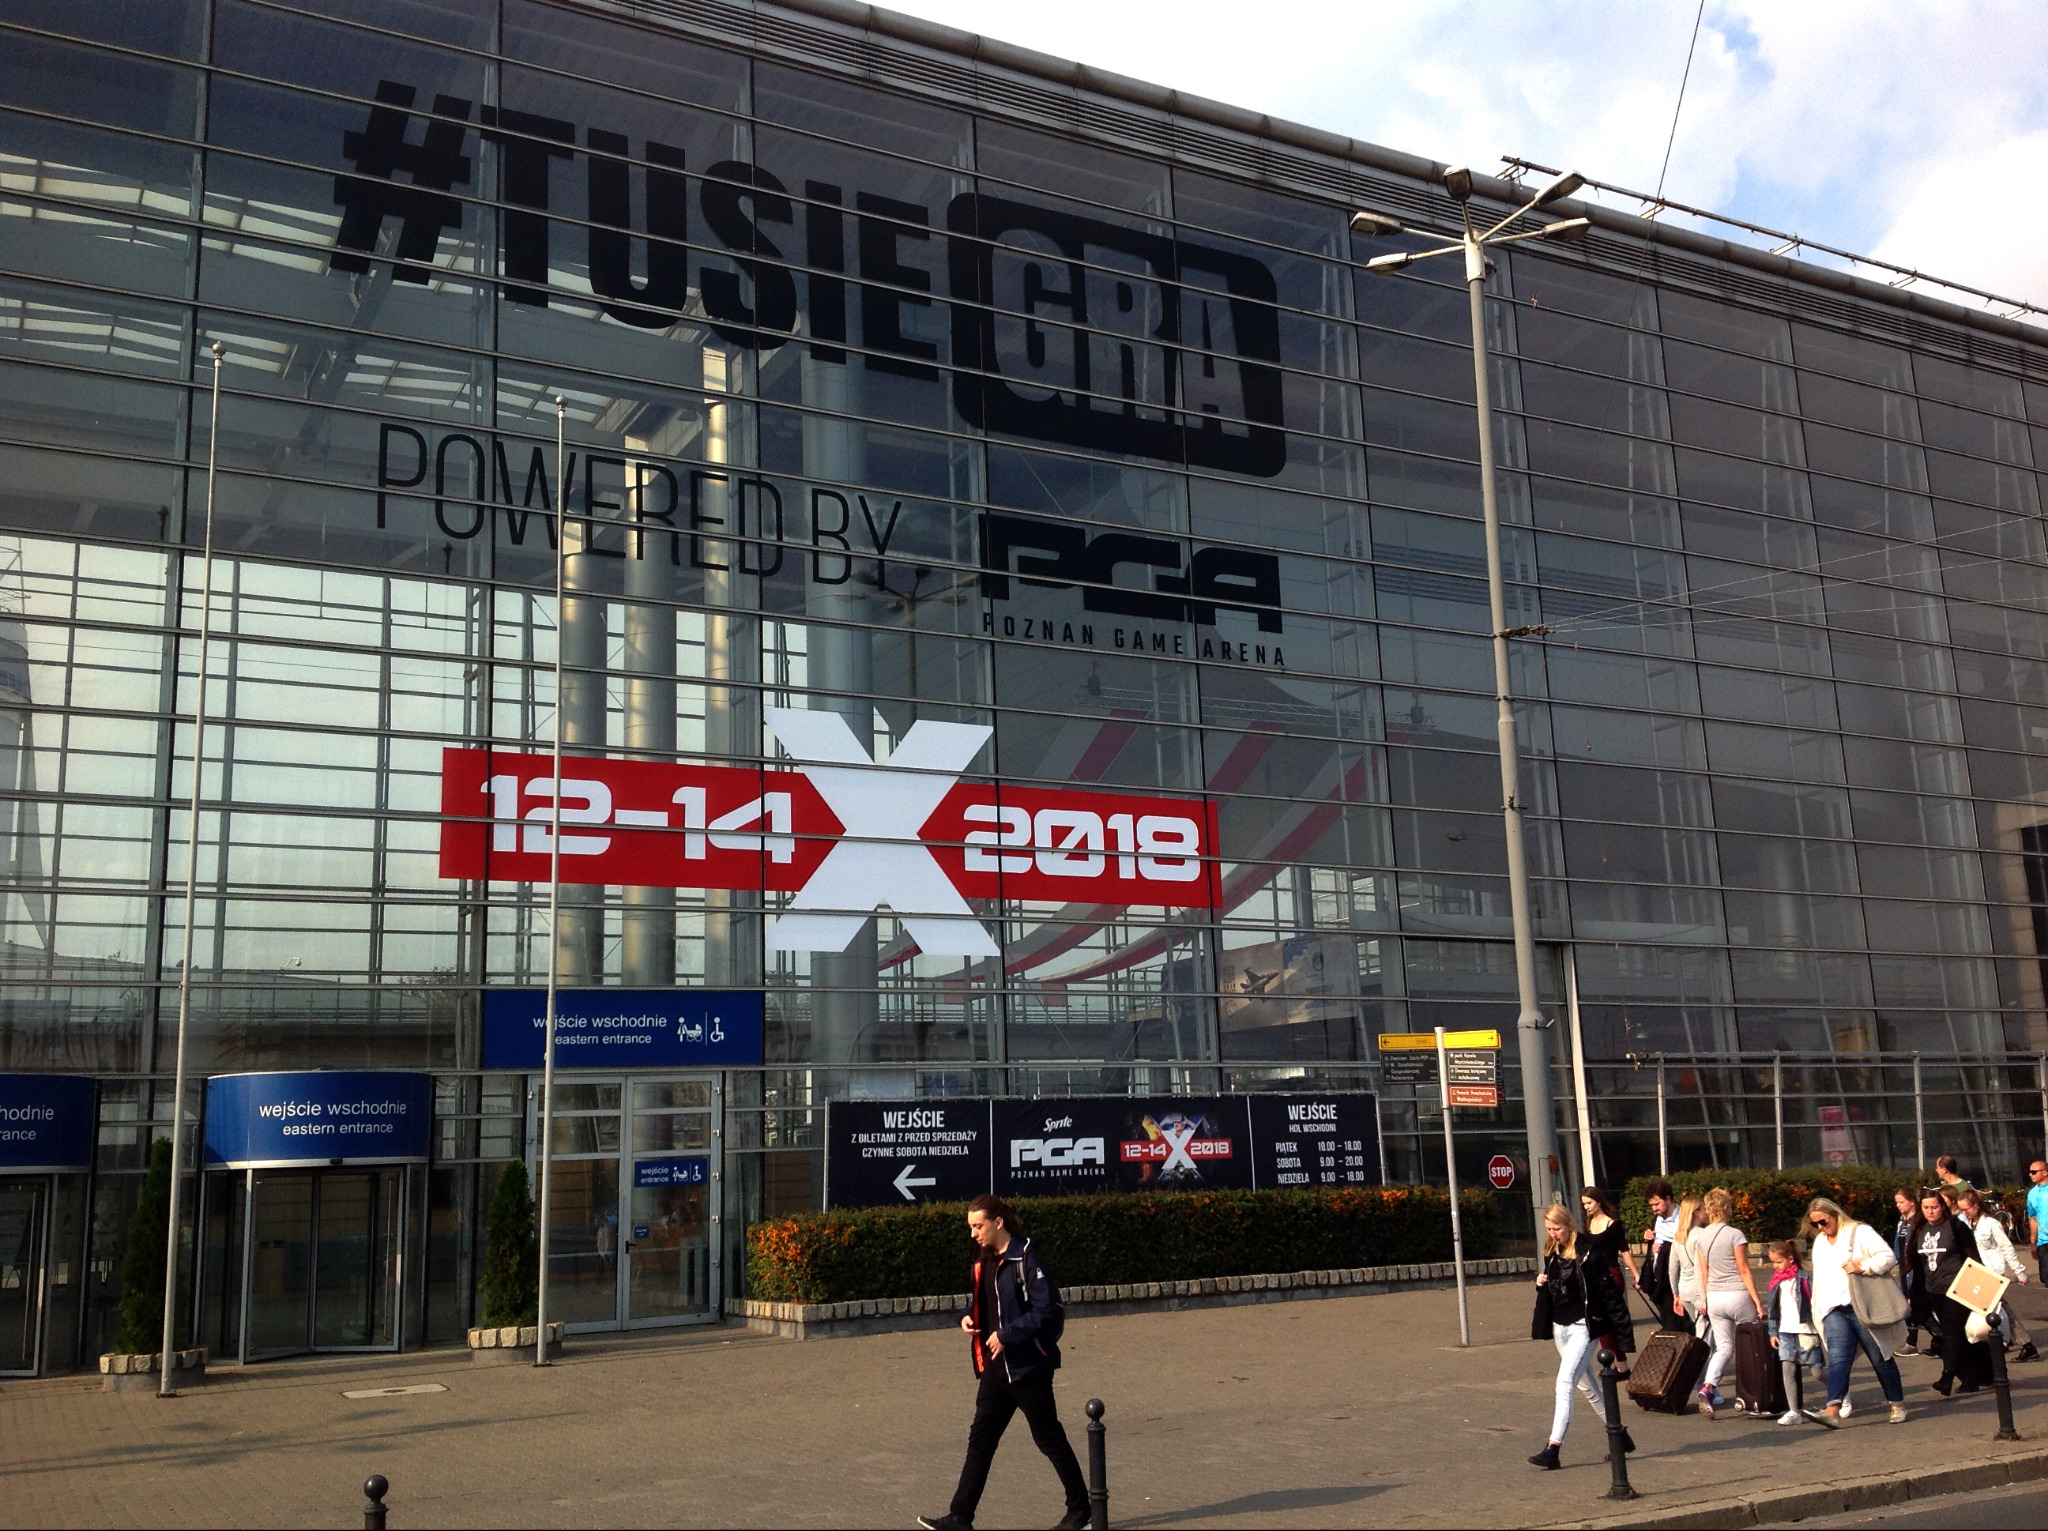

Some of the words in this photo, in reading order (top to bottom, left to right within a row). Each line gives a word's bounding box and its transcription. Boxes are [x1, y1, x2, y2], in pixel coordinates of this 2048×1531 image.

[376, 422, 784, 578] POWERED
[811, 487, 903, 591] BY
[978, 514, 1283, 634] PGA
[983, 612, 1094, 645] POZNAN
[1114, 628, 1184, 654] GAME
[1203, 638, 1285, 666] ARENA
[480, 775, 796, 864] 12-14
[764, 707, 1001, 957] X
[962, 804, 1201, 882] 2018
[592, 1014, 668, 1028] wschodnie
[555, 1033, 599, 1045] eastern
[602, 1033, 652, 1044] entrance
[259, 1101, 322, 1121] wejście
[327, 1100, 407, 1115] wschodnie
[1288, 1101, 1338, 1121] WEJŚCIE
[883, 1107, 945, 1129] WEJŚCIE
[1043, 1115, 1073, 1132] Sprite
[282, 1123, 335, 1136] eastern
[339, 1122, 394, 1134] entrance
[1289, 1124, 1303, 1133] HOL
[1303, 1123, 1337, 1132] WSCHODNI
[851, 1133, 857, 1143] Z
[858, 1132, 896, 1143] BILETAMI
[898, 1132, 904, 1143] Z
[904, 1132, 930, 1142] PRZED
[931, 1130, 977, 1141] SPRZEDAŻY
[862, 1147, 894, 1158] CZYNNE
[896, 1146, 928, 1157] SOBOTA
[929, 1145, 969, 1156] NIEDZIELA
[1011, 1137, 1105, 1168] PGA
[1124, 1143, 1167, 1157] 12-14
[1190, 1142, 1229, 1155] 2018
[1275, 1141, 1298, 1154] PIĄTEK
[1318, 1141, 1336, 1151] 10.00
[1344, 1140, 1362, 1151] 18.00
[1276, 1158, 1302, 1168] SOBOTA
[1319, 1156, 1335, 1167] 9.00
[1345, 1156, 1364, 1166] 20.00
[1050, 1169, 1073, 1177] GAME
[1078, 1168, 1105, 1176] ARENA
[1277, 1172, 1310, 1184] NIEDZIELA
[1320, 1171, 1336, 1182] 9.00
[1346, 1171, 1365, 1181] 18.00
[1491, 1166, 1512, 1178] STOP
